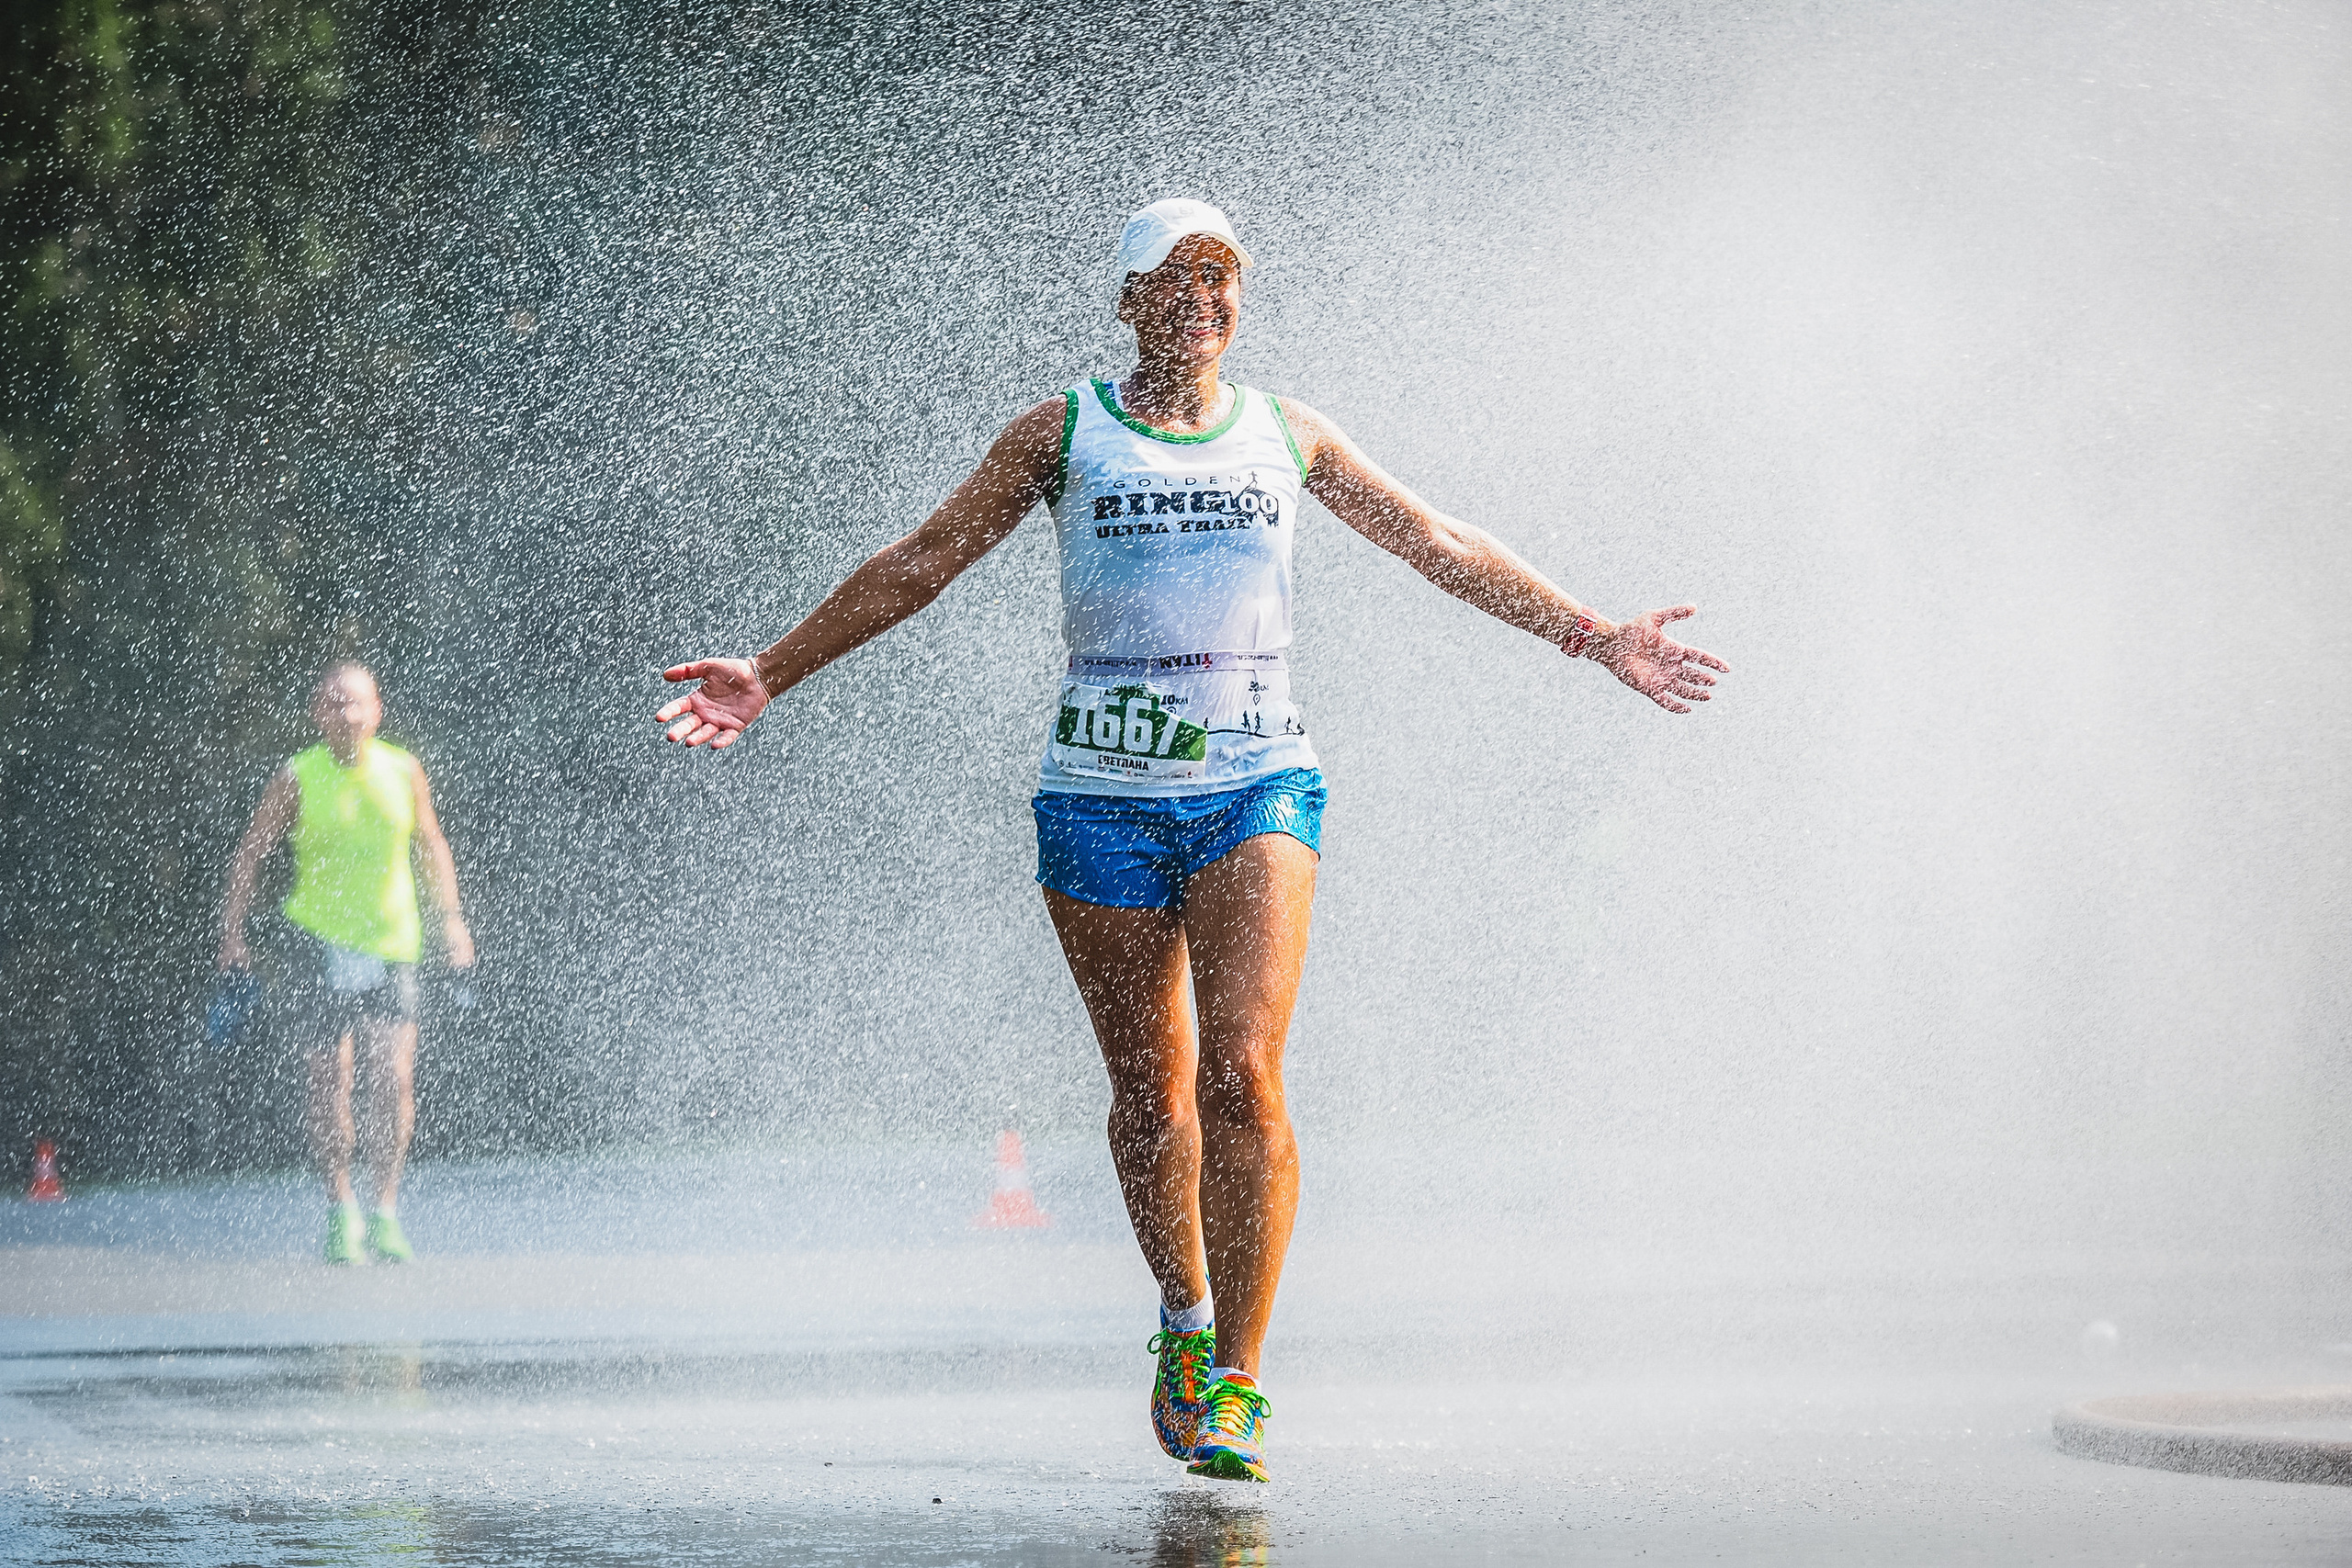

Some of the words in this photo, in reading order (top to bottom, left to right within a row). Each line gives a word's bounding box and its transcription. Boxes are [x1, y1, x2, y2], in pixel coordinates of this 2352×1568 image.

[1113, 476, 1240, 489] GOLDEN
[1091, 491, 1224, 521] RING
[1221, 492, 1278, 514] 100
[1095, 522, 1170, 538] ULTRA
[1098, 754, 1148, 771] СВЕТЛАНА
